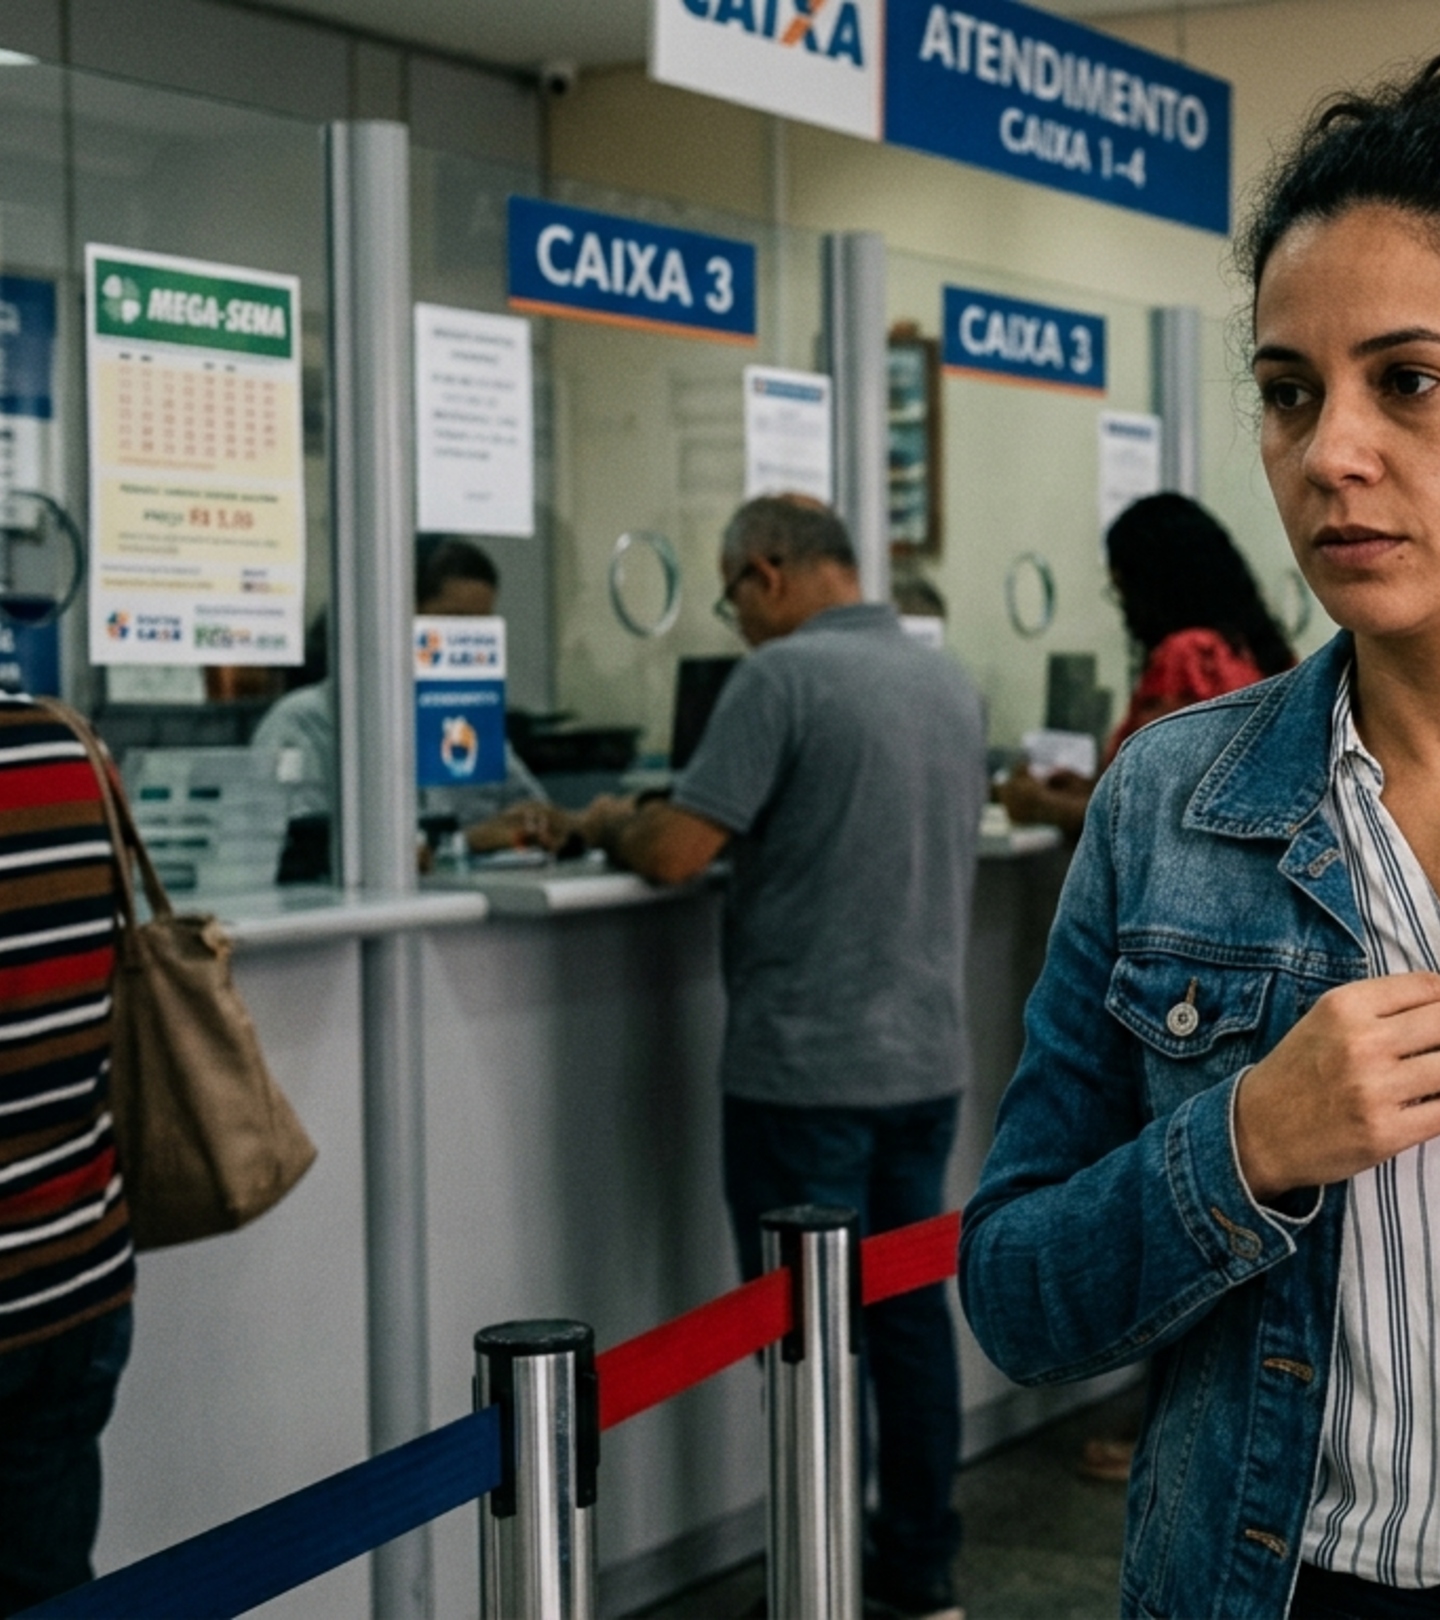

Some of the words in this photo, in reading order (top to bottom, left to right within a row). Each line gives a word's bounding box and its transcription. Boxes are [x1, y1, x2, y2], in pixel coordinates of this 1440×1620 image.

[919, 4, 1208, 151] ATENDIMENTO
[1000, 107, 1090, 175] CAIXA
[536, 223, 692, 307] CAIXA
[705, 256, 734, 315] 3
[147, 287, 287, 338] MEGA-SENA
[959, 305, 1062, 365] CAIXA
[1069, 328, 1093, 375] 3
